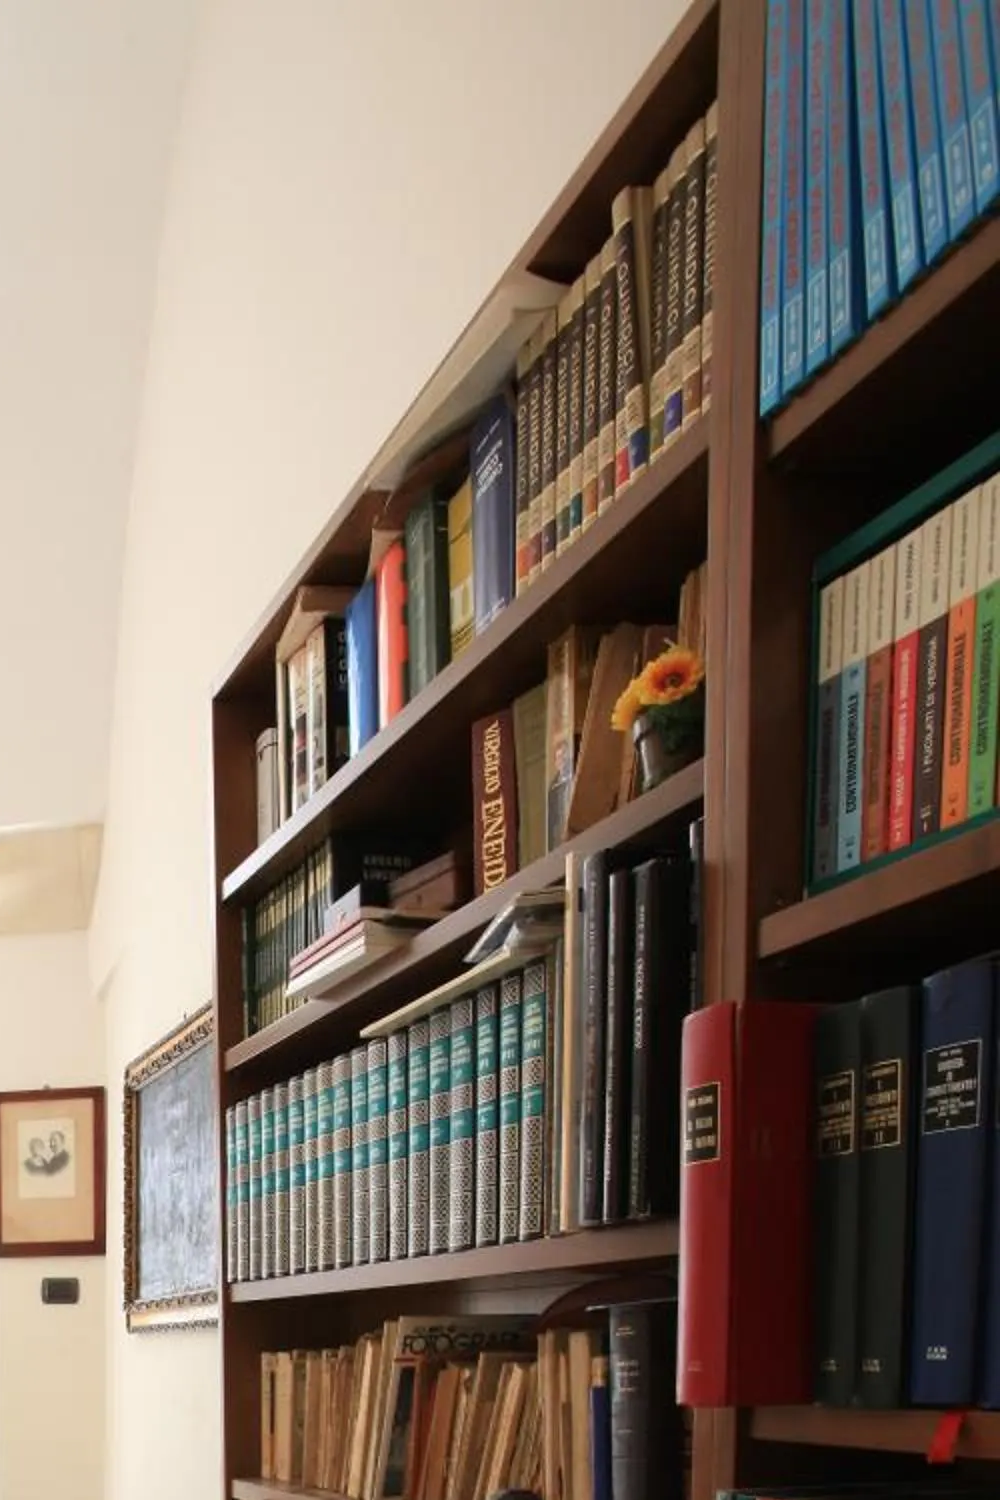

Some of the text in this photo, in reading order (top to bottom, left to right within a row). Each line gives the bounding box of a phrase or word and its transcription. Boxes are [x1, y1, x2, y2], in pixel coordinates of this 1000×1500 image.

[684, 195, 698, 317] QUINDICI
[529, 387, 541, 486] QUINDICI
[482, 720, 506, 894] VIRGILIO ENEID
